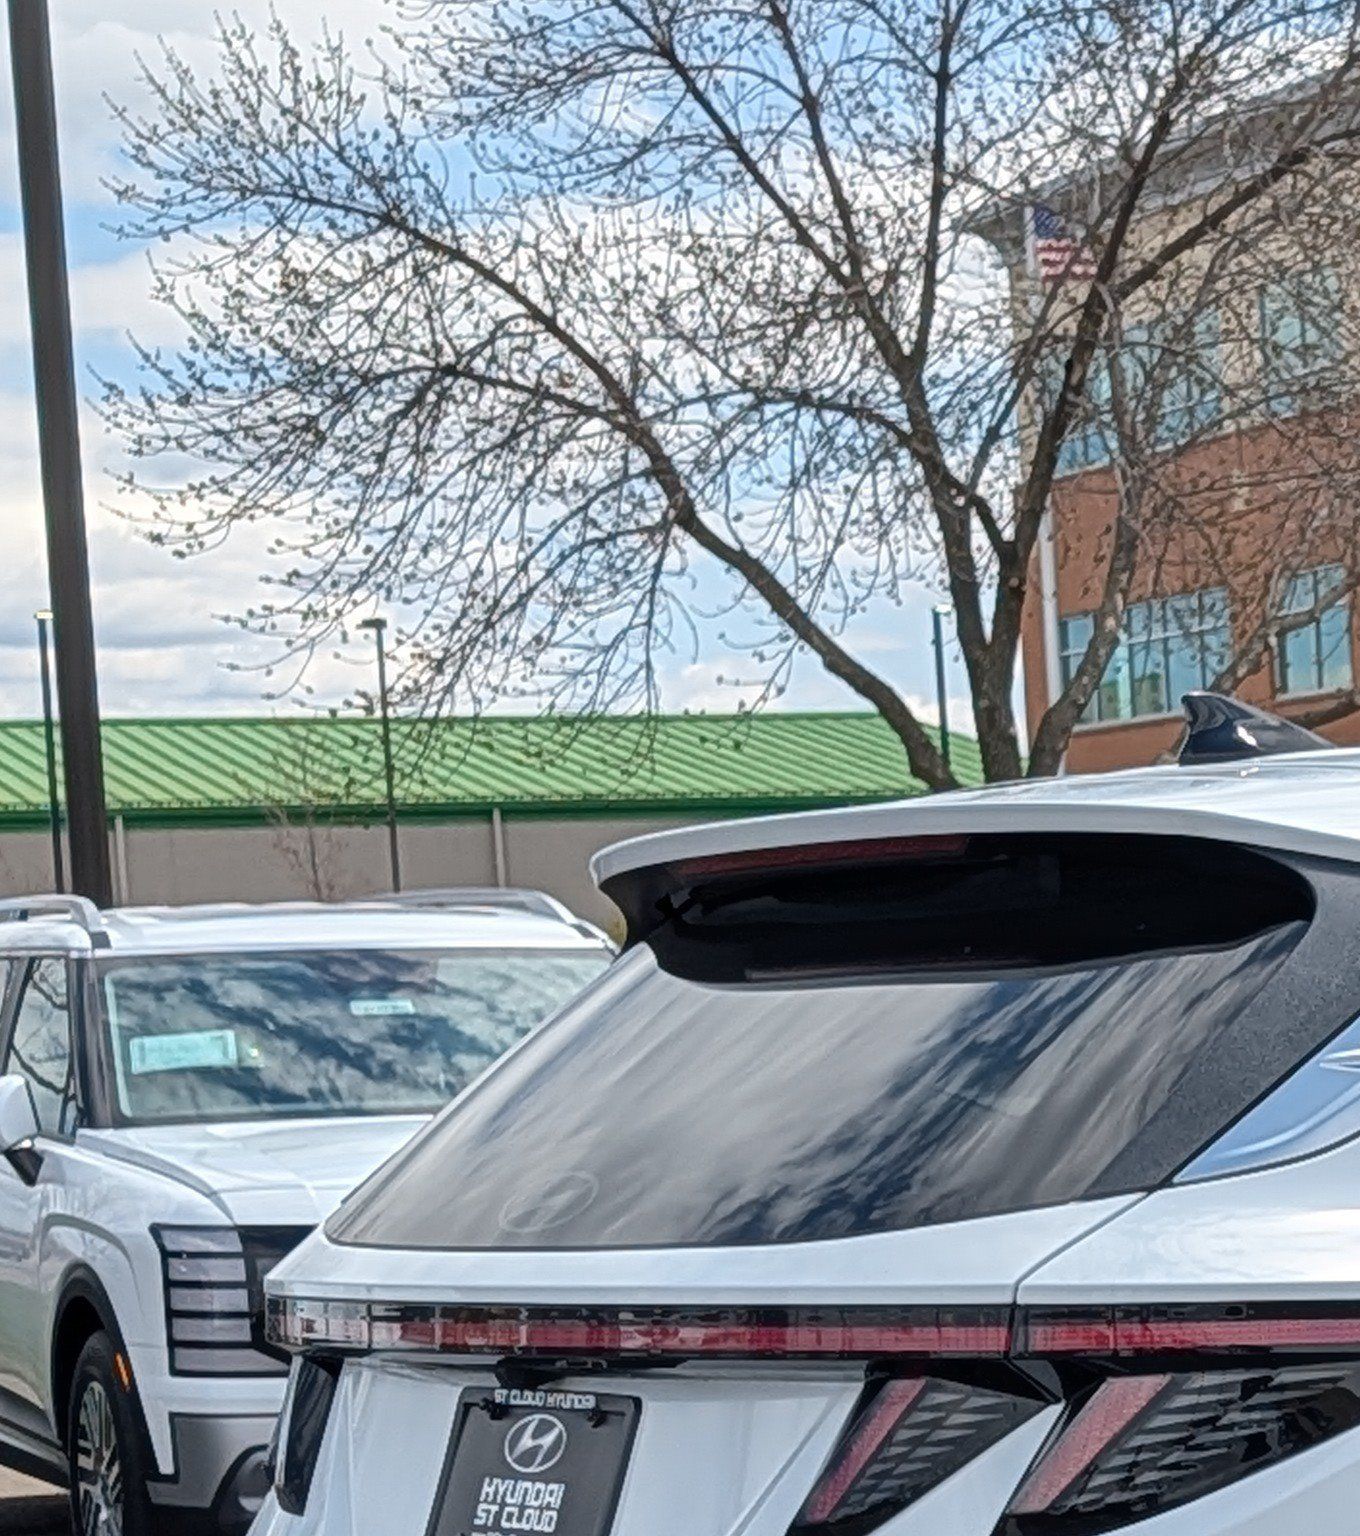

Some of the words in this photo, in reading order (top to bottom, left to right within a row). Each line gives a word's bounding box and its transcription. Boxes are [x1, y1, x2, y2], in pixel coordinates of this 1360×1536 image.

[479, 1477, 566, 1510] HYUNDAI
[473, 1502, 500, 1528] ST
[500, 1505, 559, 1534] CLOUD
